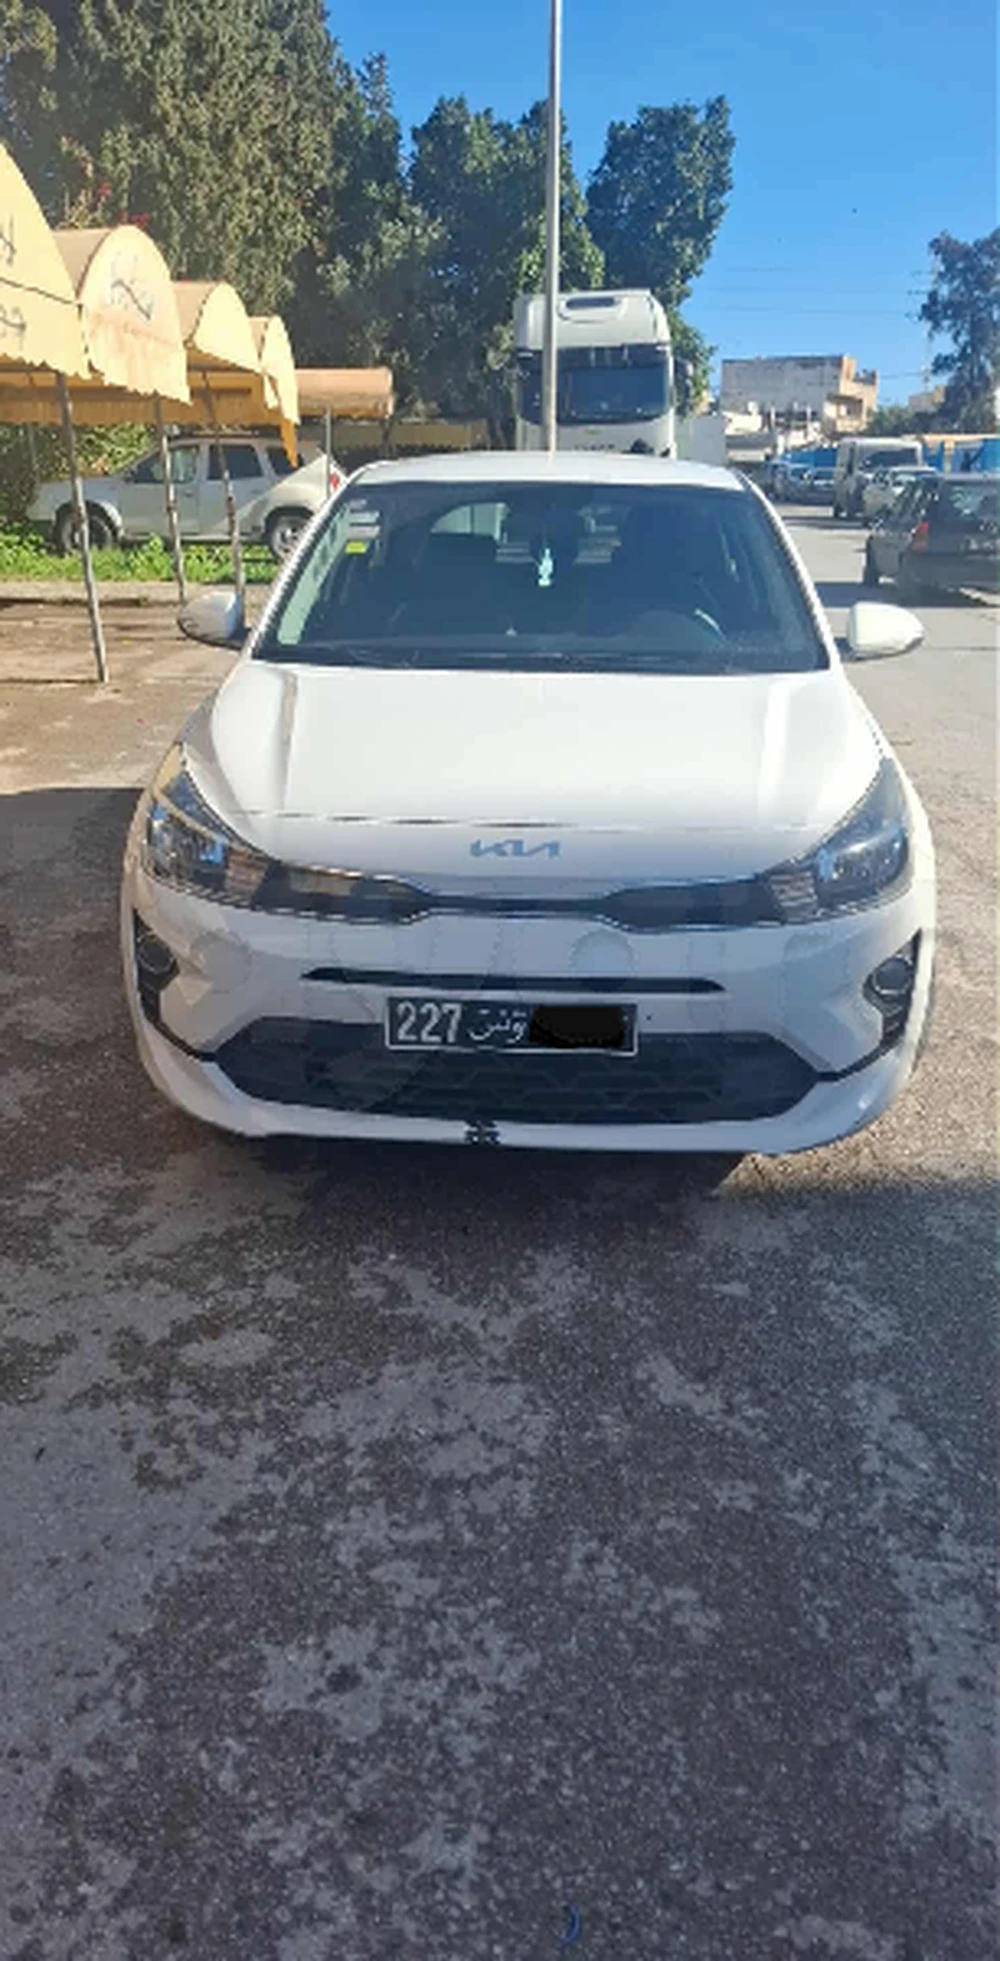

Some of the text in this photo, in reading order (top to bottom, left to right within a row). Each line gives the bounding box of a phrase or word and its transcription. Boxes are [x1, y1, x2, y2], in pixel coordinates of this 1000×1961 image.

[470, 839, 560, 857] KIA
[396, 1001, 462, 1043] 227
[468, 1008, 528, 1044] تونس
